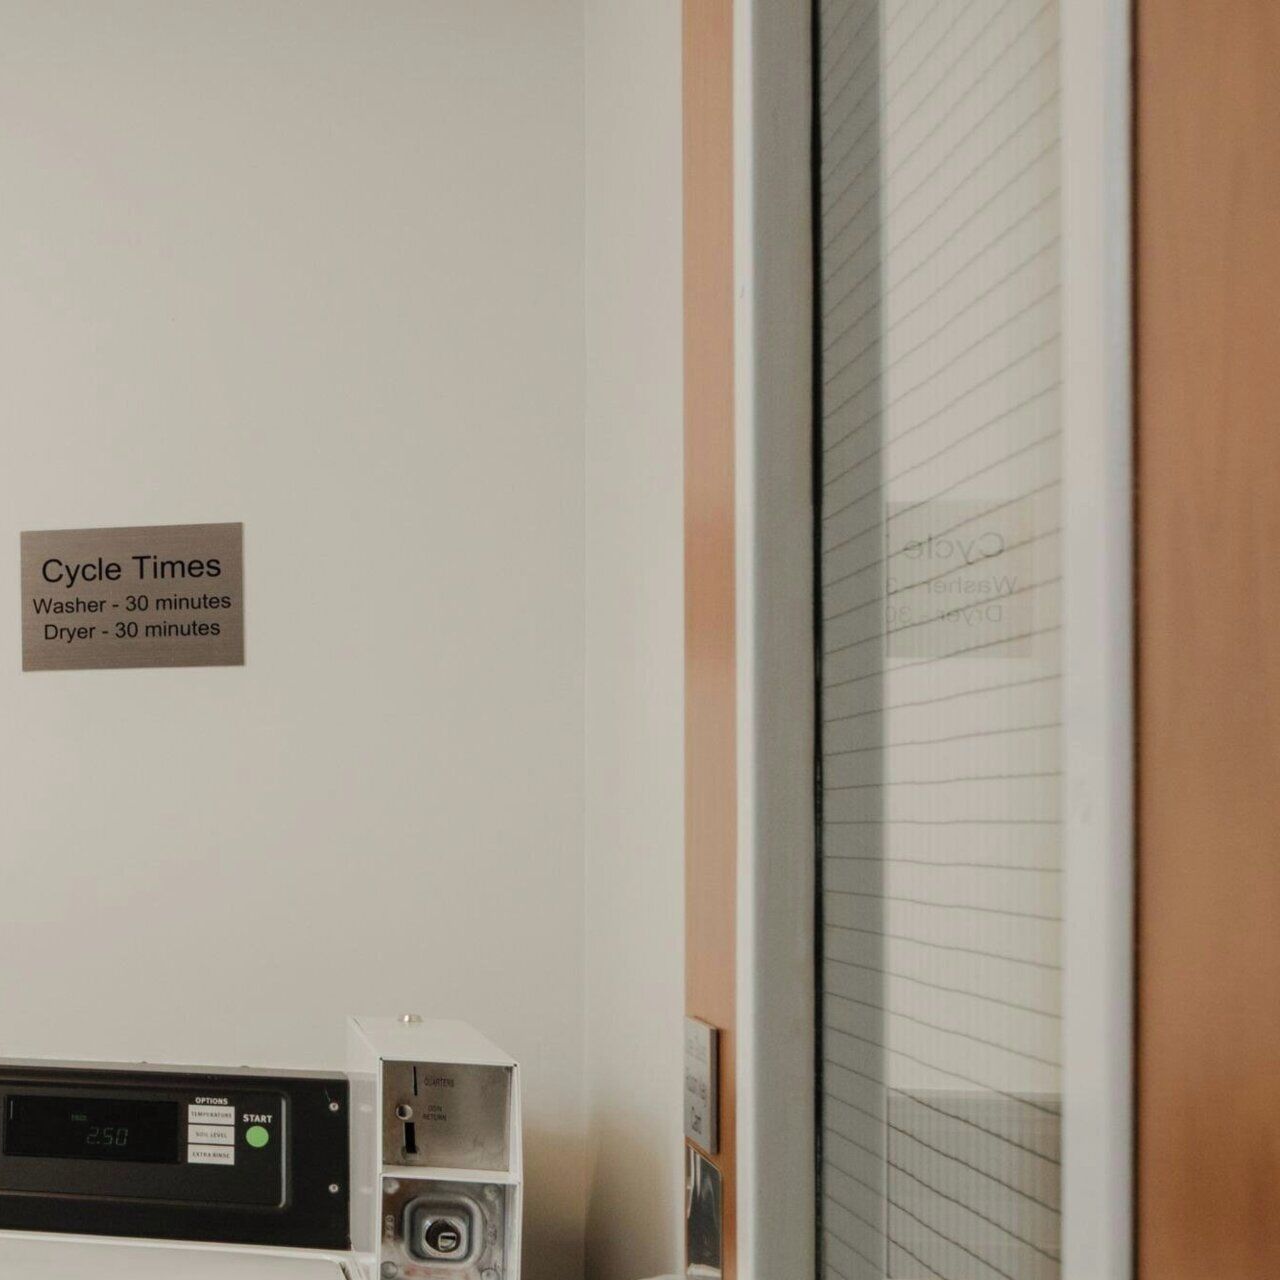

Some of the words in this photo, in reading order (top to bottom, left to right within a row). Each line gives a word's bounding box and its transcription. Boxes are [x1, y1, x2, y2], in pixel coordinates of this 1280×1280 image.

[41, 557, 122, 588] Cycle
[131, 555, 222, 580] Times
[32, 596, 107, 615] Washer
[125, 595, 149, 612] 30
[155, 594, 232, 611] minutes
[44, 623, 96, 643] Dryer
[115, 622, 139, 638] 30
[144, 620, 221, 638] minutes
[195, 1096, 228, 1105] OPTIONS
[242, 1113, 273, 1123] START
